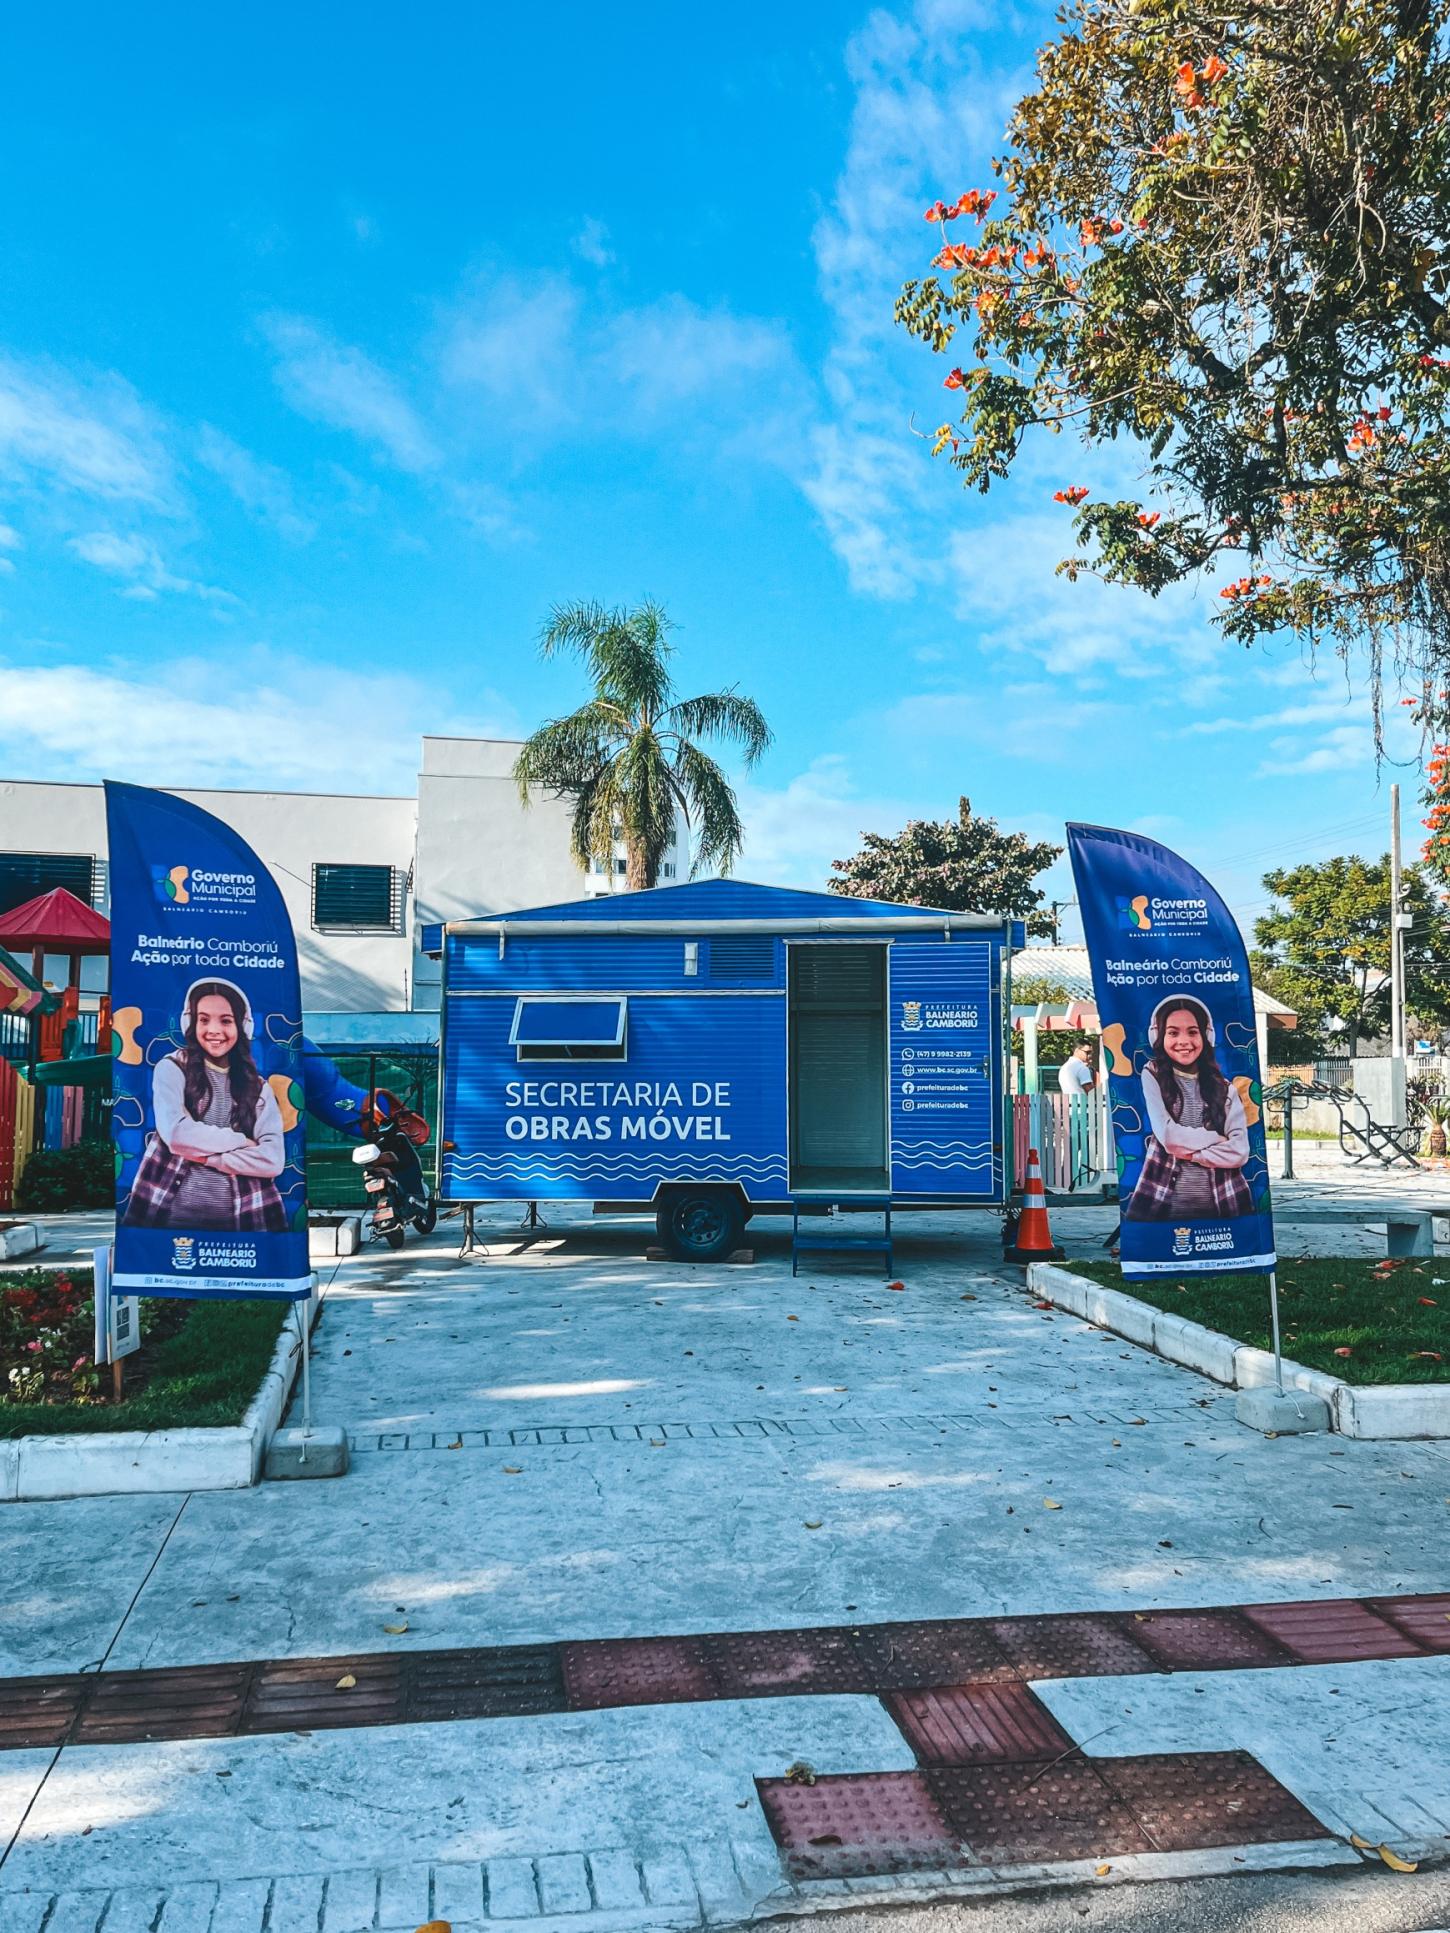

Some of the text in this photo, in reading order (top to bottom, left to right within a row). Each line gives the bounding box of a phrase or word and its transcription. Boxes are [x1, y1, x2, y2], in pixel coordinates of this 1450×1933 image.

[191, 869, 255, 884] Governo
[191, 881, 256, 898] Municipal
[1151, 898, 1206, 909] Governo
[1152, 908, 1208, 920] Municipal
[138, 934, 278, 953] Balneário Camboriú
[131, 950, 285, 968] Ação por toda Cidade
[1105, 957, 1232, 971] Balneário Camboriú
[1106, 971, 1240, 987] Ação por toda Cidade
[505, 1082, 732, 1107] SECRETARIA DE
[917, 1084, 969, 1092] prefeituradebc
[505, 1108, 732, 1141] OBRAS MÓVEL
